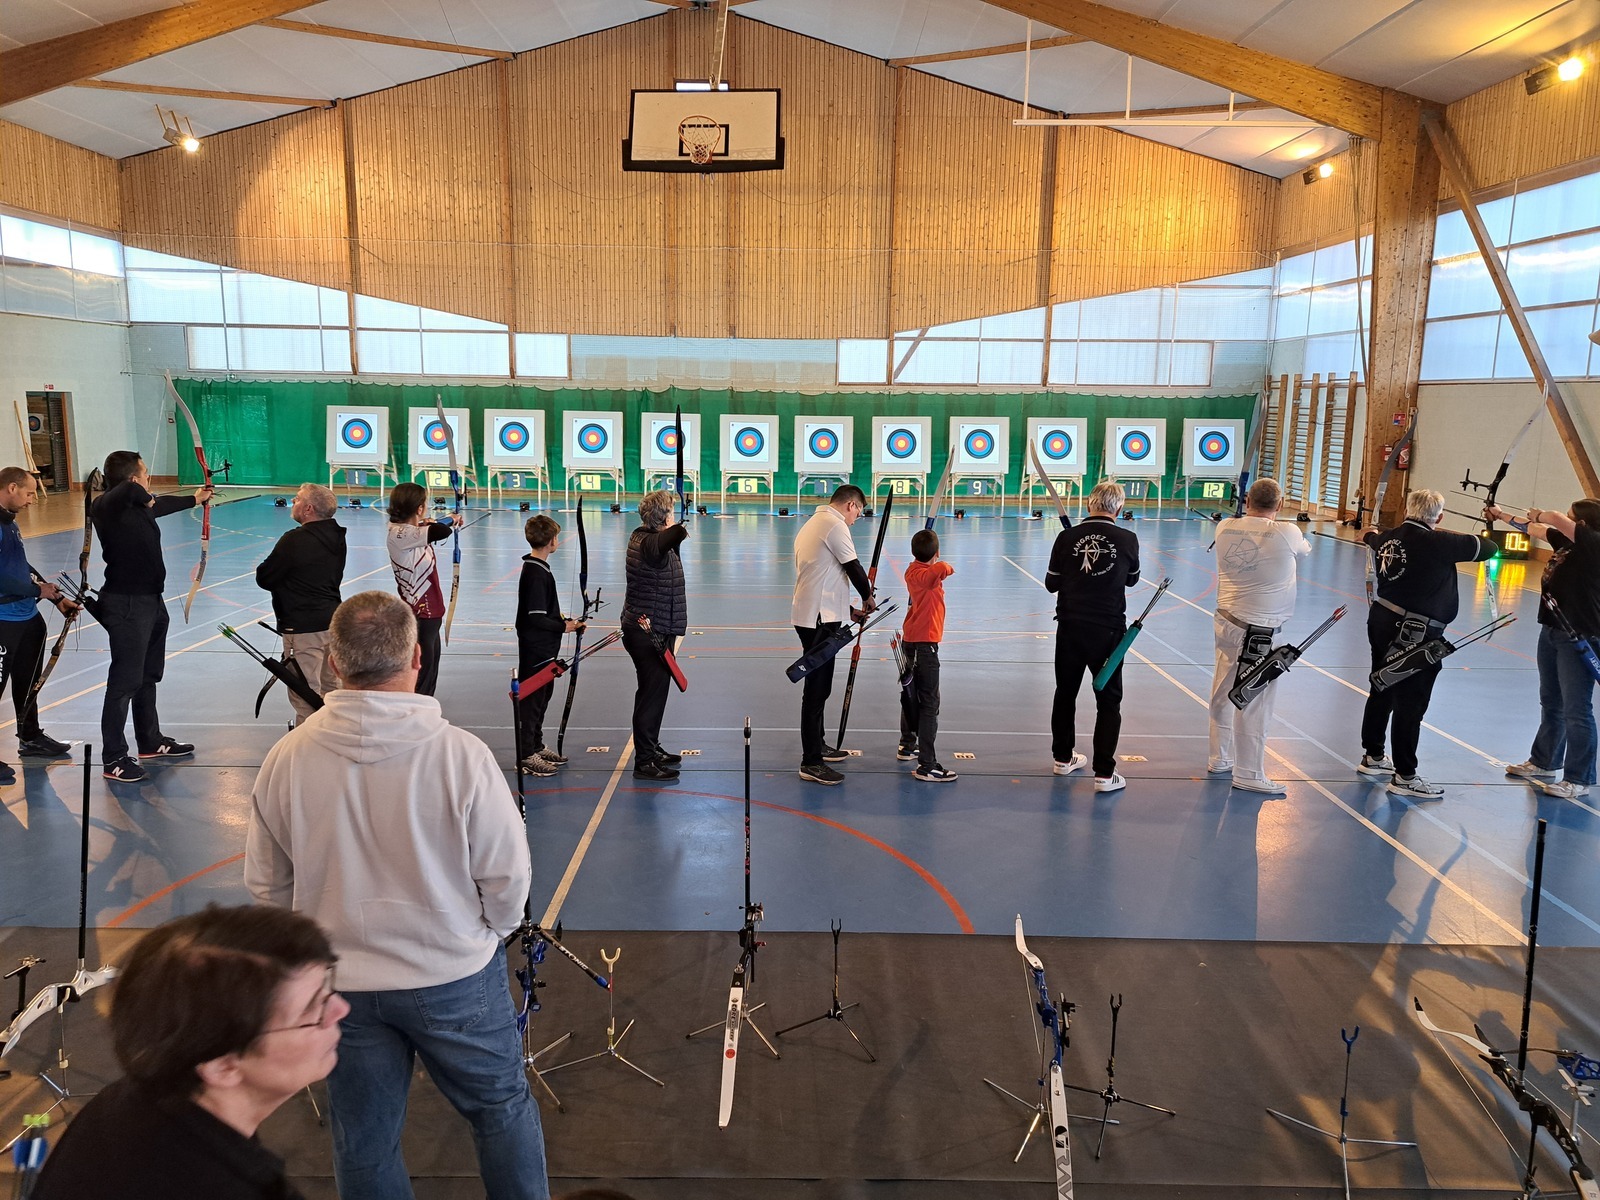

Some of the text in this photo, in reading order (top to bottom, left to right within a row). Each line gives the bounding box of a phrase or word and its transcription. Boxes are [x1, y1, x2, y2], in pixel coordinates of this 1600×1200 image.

[354, 471, 359, 484] 1
[434, 471, 442, 485] 2
[512, 473, 520, 488] 3
[586, 476, 594, 489] 4
[666, 477, 675, 490] 5
[744, 478, 752, 492] 6
[820, 479, 827, 493] 7
[896, 480, 904, 493] 8
[973, 480, 981, 495] 9
[1130, 482, 1140, 496] 11
[1208, 483, 1220, 497] 12
[1072, 534, 1106, 557] LANGROEZ
[1107, 543, 1117, 559] ARC
[1386, 642, 1417, 663] AVALON
[1240, 656, 1265, 680] AVALON
[157, 745, 171, 754] N
[112, 766, 124, 777] N
